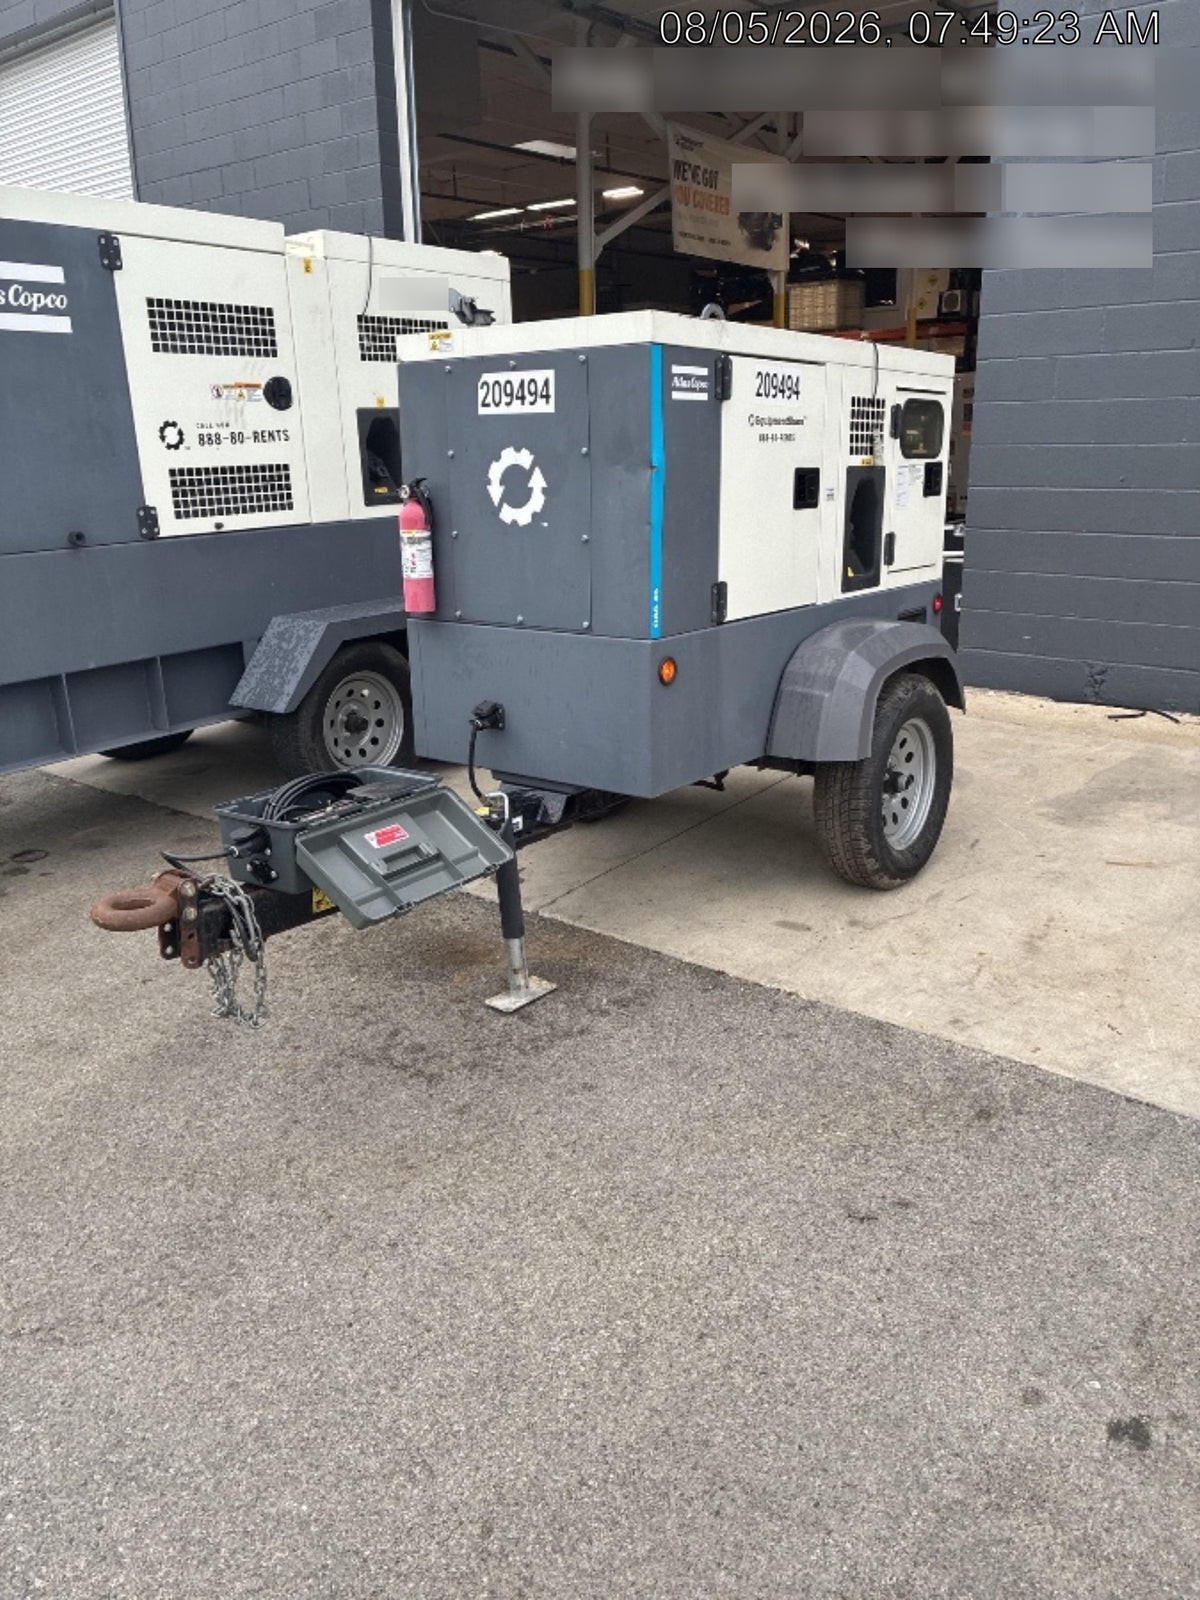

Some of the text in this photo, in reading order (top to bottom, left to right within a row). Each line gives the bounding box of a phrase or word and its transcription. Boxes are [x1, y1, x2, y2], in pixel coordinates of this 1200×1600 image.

[8, 284, 68, 312] Copco
[480, 377, 551, 408] 209494
[755, 371, 801, 400] 209494
[198, 429, 290, 446] 888-80-RENTS
